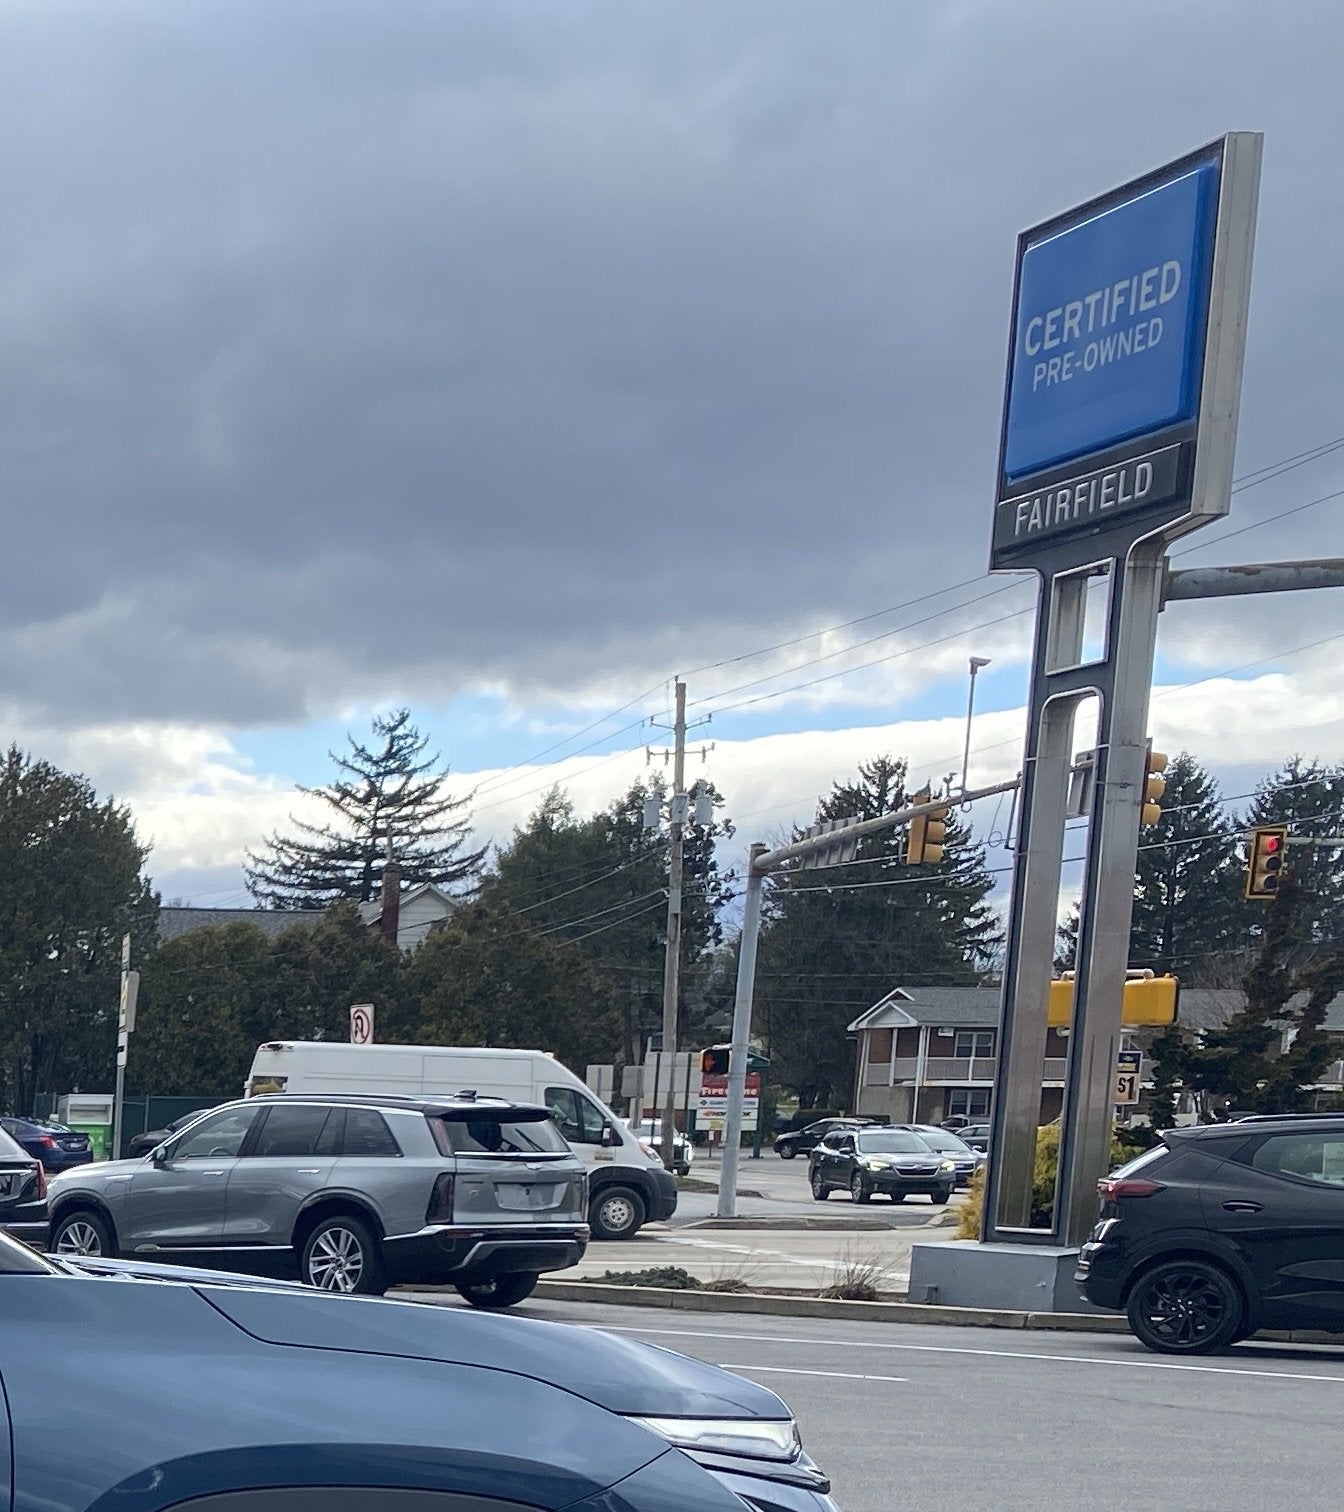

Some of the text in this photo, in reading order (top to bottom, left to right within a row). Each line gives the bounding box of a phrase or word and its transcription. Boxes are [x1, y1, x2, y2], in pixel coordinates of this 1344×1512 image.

[1023, 258, 1182, 357] CERTIFIED
[1032, 316, 1164, 392] PRE-OWNED
[1014, 460, 1154, 537] FAIRFIELD
